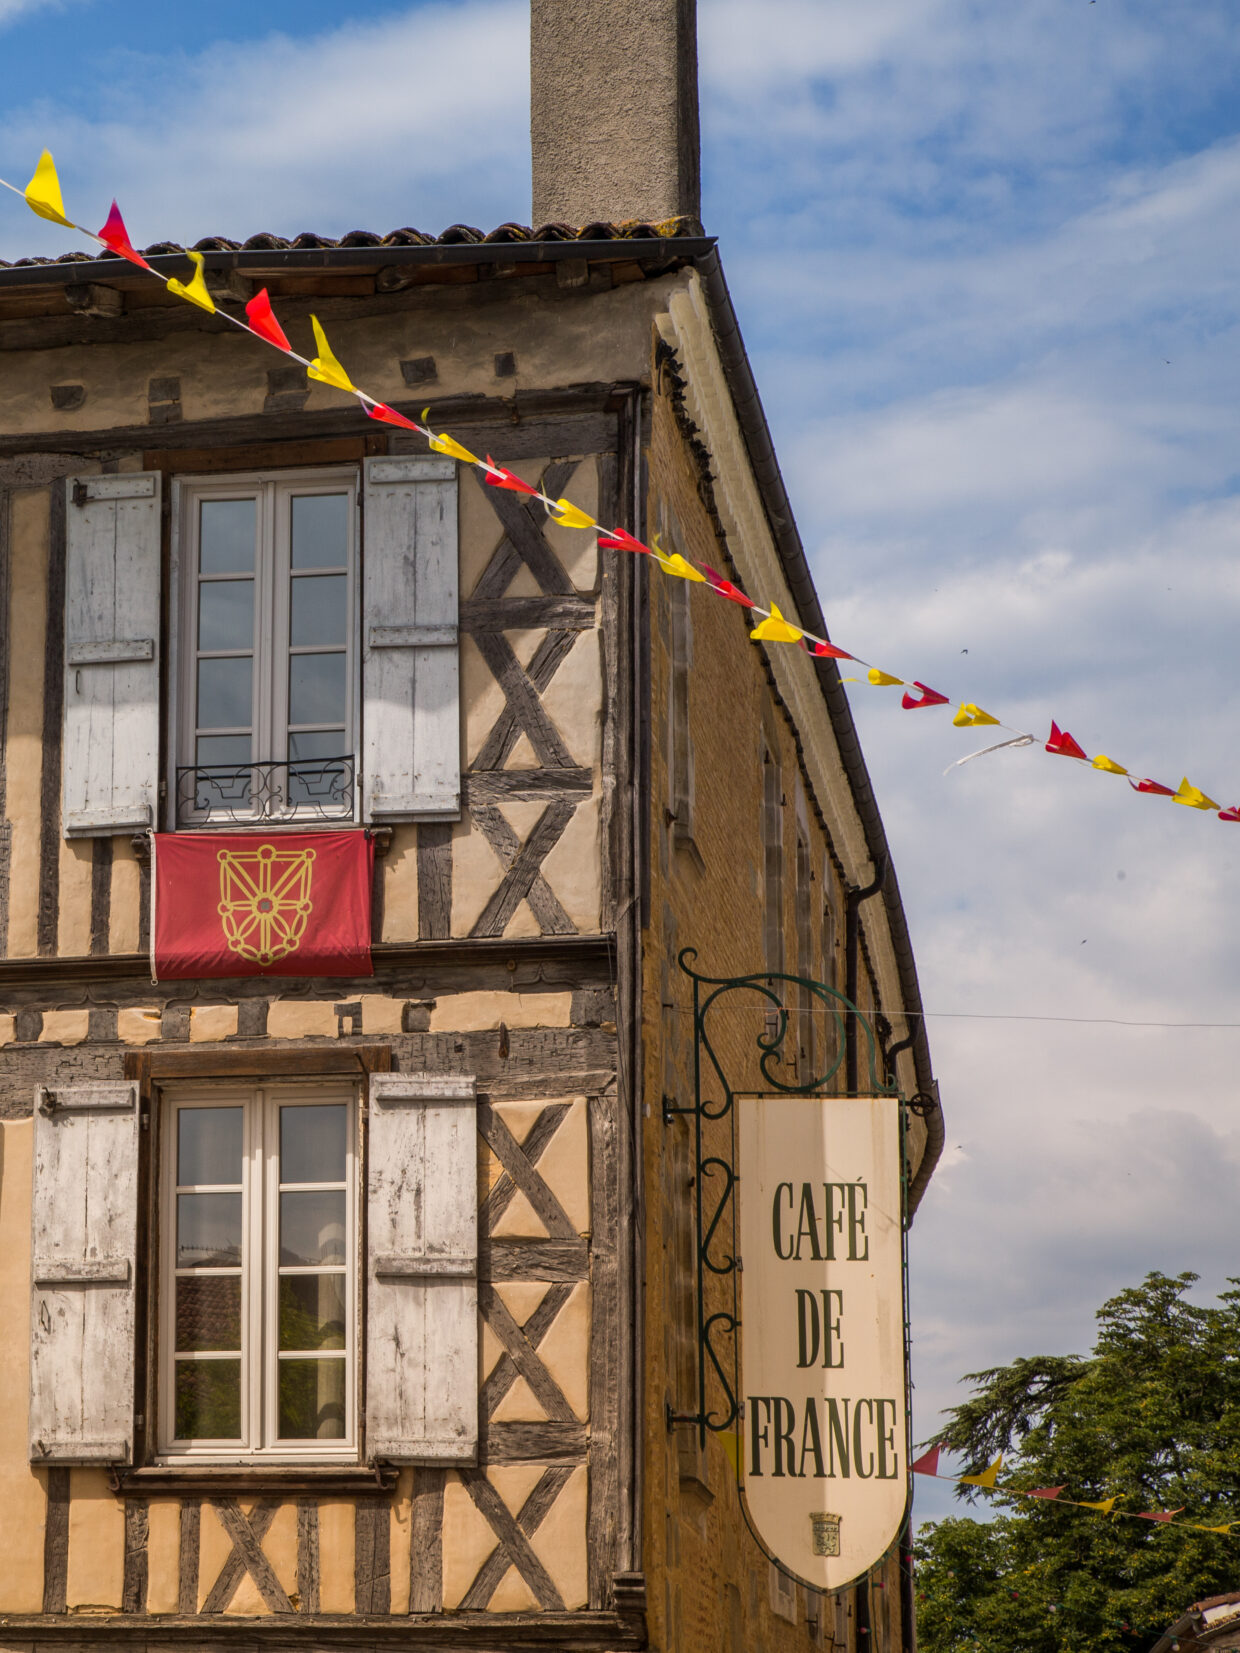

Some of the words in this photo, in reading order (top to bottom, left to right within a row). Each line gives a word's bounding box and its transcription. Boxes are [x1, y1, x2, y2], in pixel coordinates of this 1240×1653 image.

[772, 1176, 869, 1261] CAFÉ
[795, 1289, 844, 1369] DE
[747, 1396, 899, 1480] FRANCE
